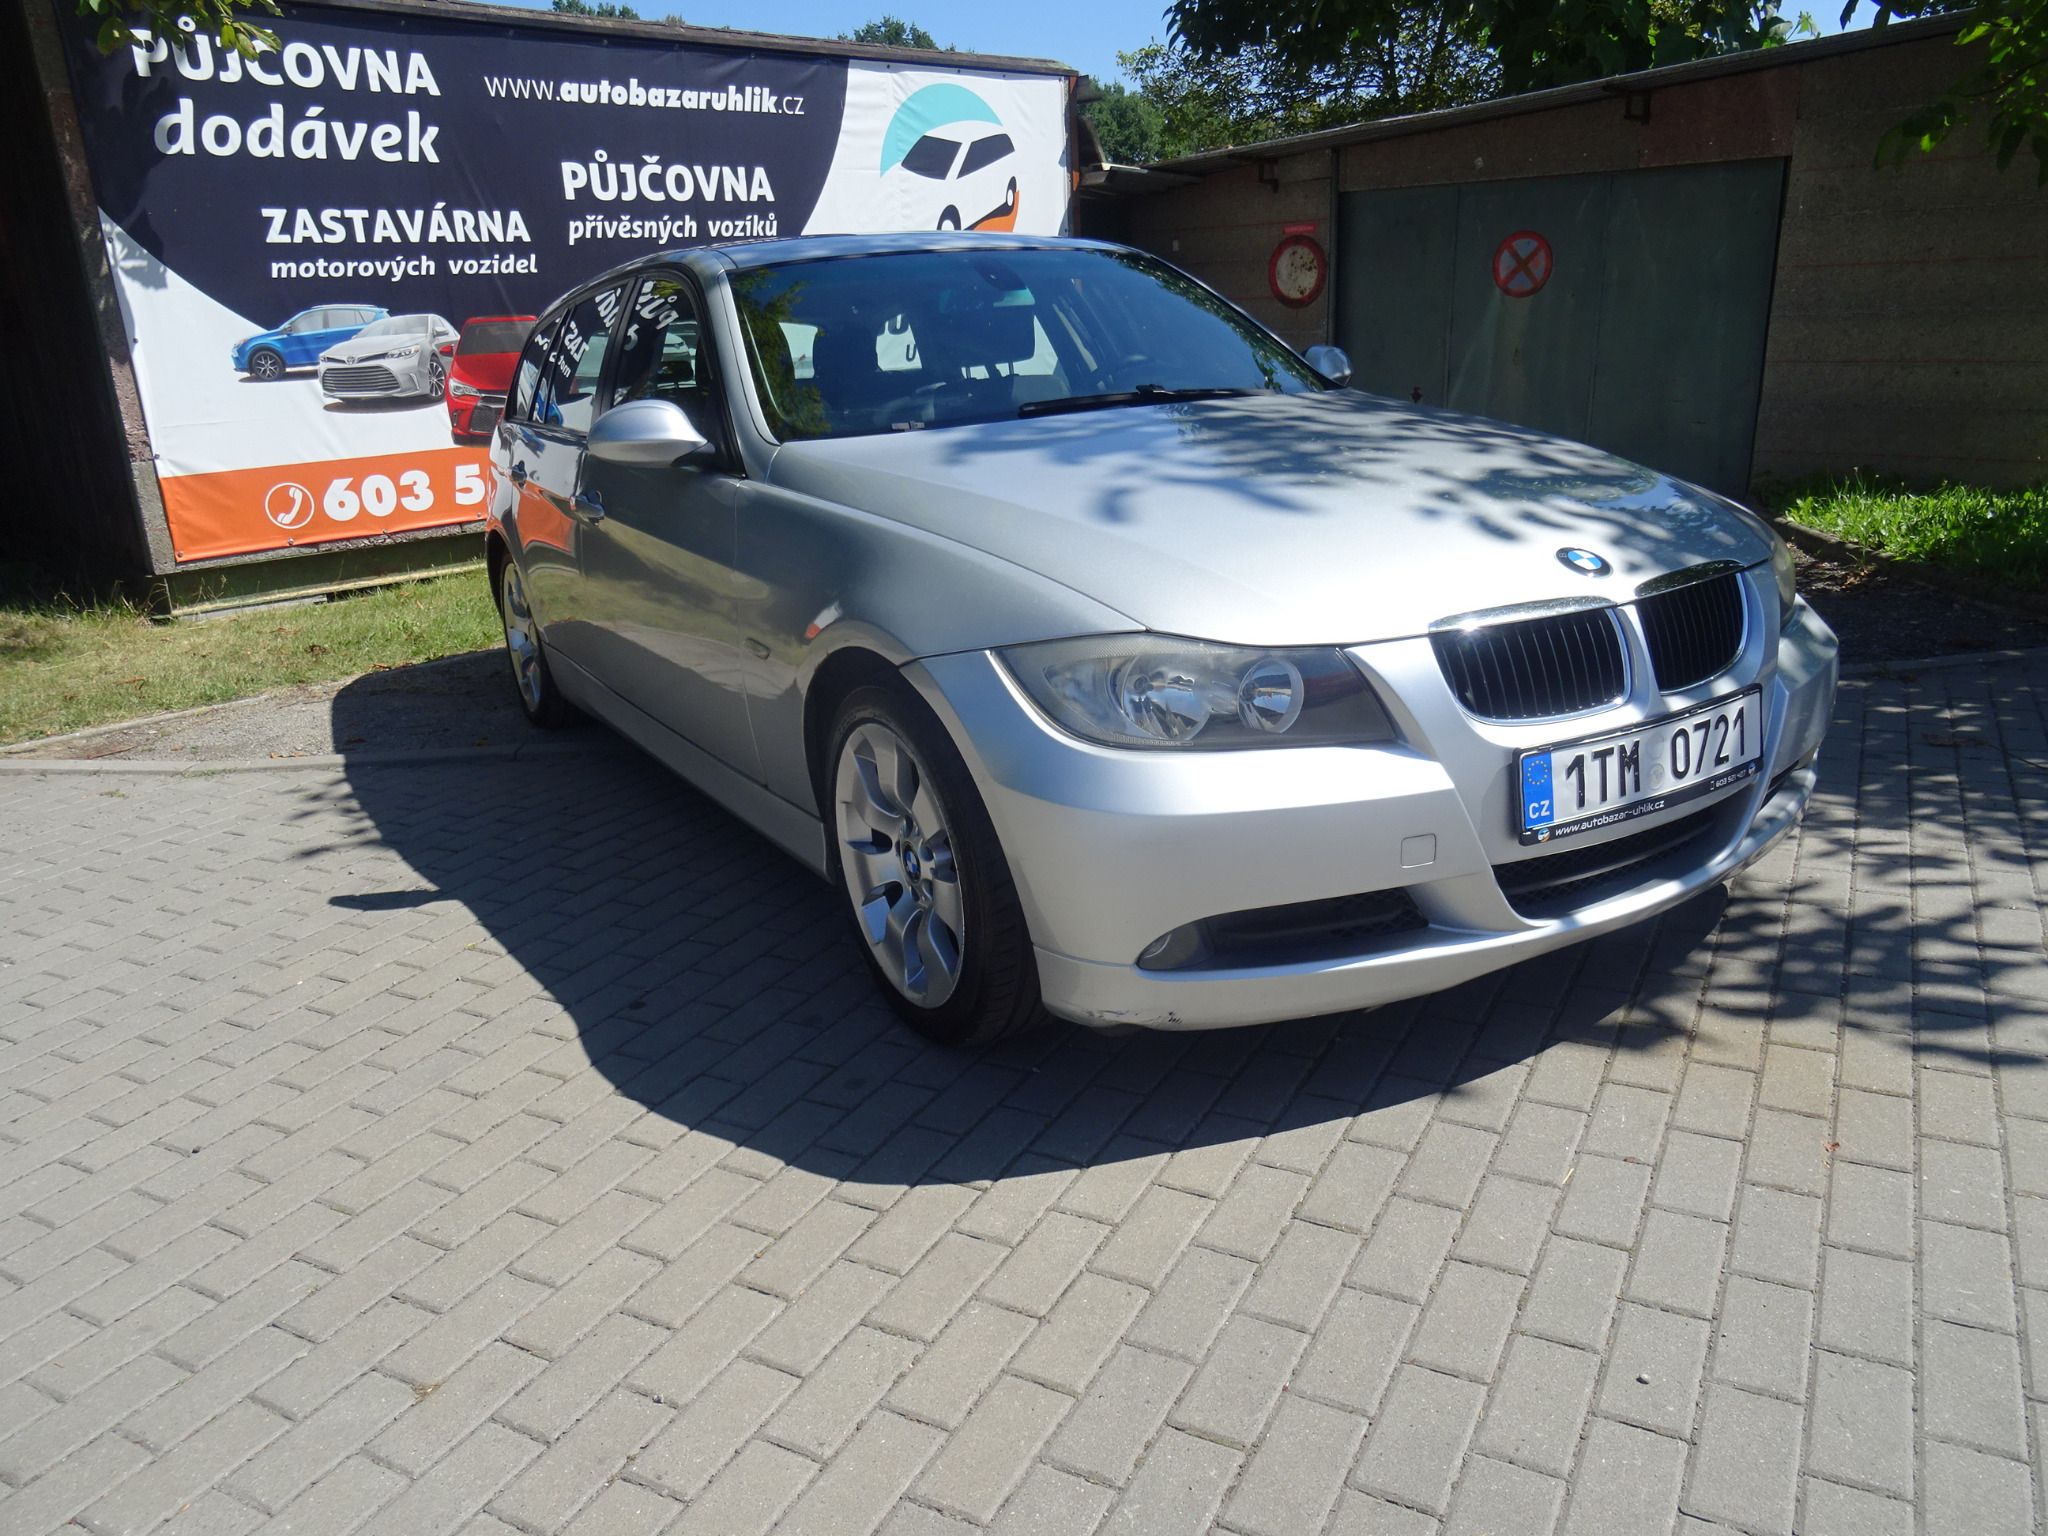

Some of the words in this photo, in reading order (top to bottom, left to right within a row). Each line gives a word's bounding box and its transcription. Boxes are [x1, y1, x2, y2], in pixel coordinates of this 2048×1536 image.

[484, 76, 805, 115] www.autobazaruhlik.cz
[154, 98, 440, 163] dodávek
[561, 150, 775, 203] PŮJČOVNA
[261, 202, 532, 244] ZASTAVÁRNA
[569, 214, 698, 245] přívěsných
[707, 212, 778, 237] vozíků
[271, 255, 436, 281] motorových
[449, 254, 538, 275] vozidel
[323, 470, 434, 522] 603
[1565, 739, 1641, 808] 1TM
[1670, 705, 1745, 780] 0721
[1529, 800, 1550, 819] CZ
[1555, 800, 1665, 836] www.autobazar-uhlik.cz
